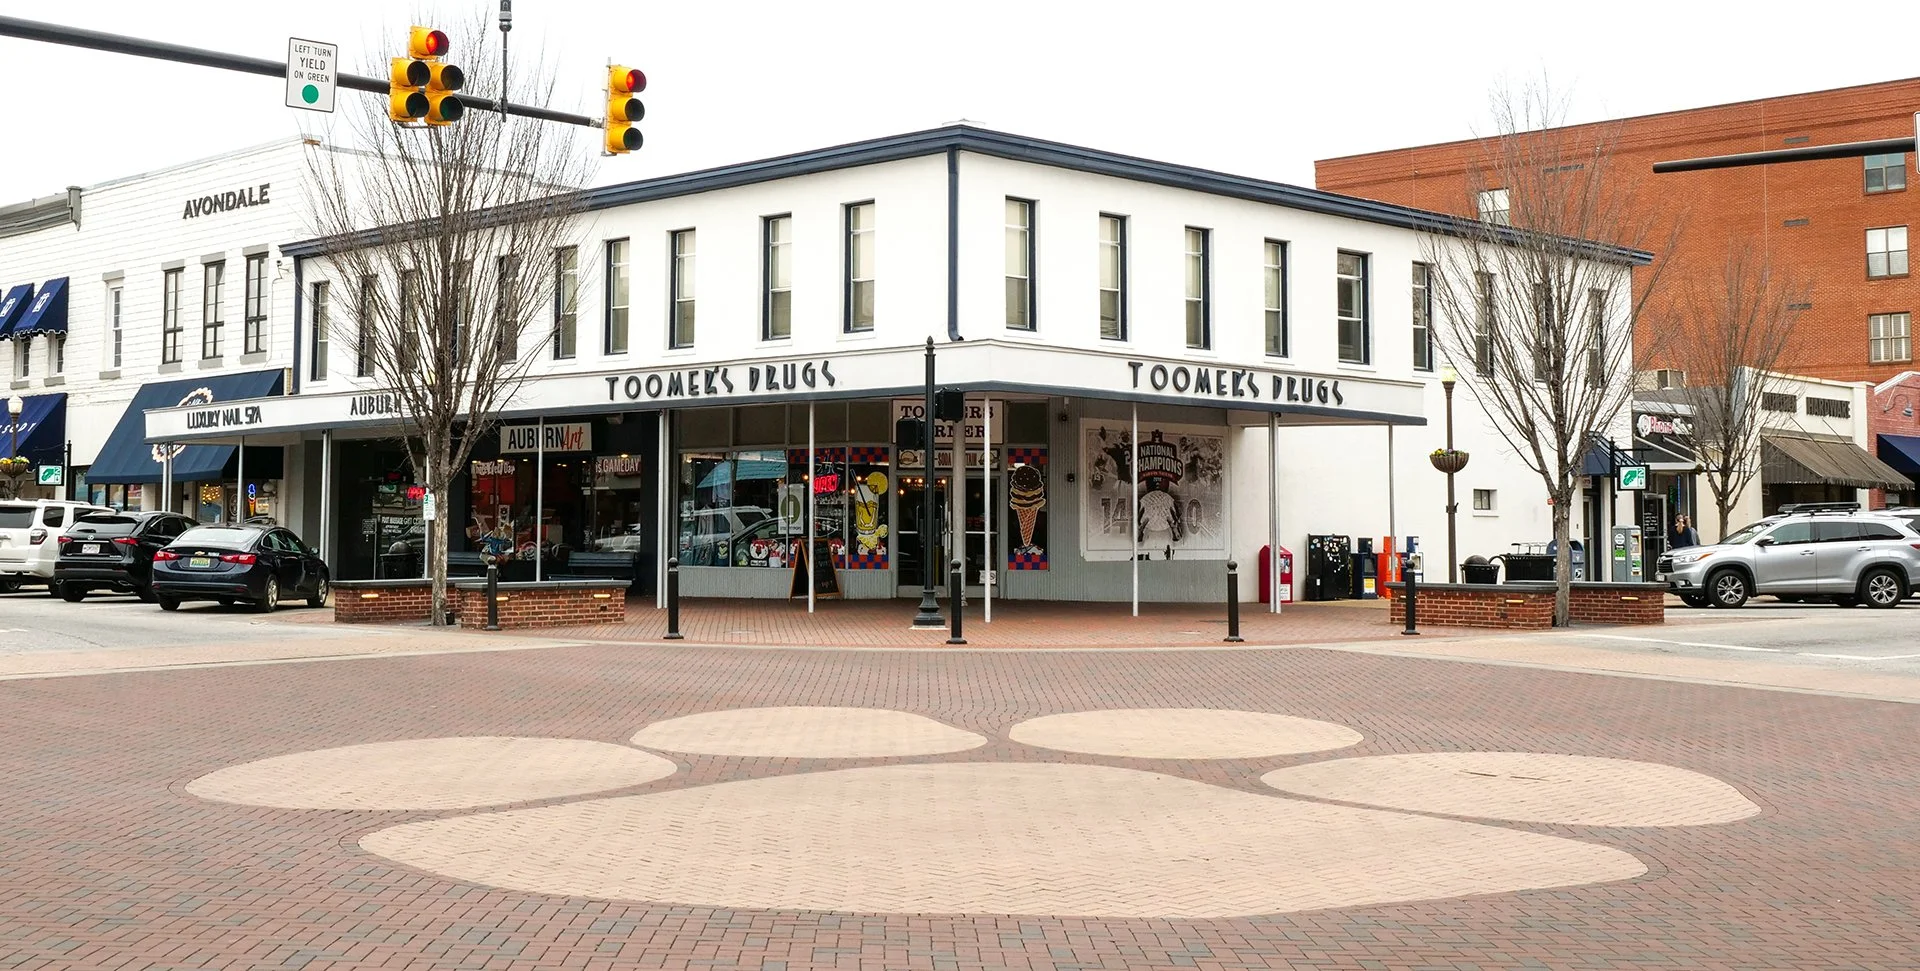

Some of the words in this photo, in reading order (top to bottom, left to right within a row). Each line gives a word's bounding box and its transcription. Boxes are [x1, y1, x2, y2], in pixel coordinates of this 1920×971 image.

[294, 44, 311, 54] LEFT
[312, 46, 332, 57] TURN
[299, 57, 326, 71] YIELD
[294, 70, 304, 79] ON
[307, 72, 330, 83] GREEN
[182, 182, 270, 219] AVONDALE
[605, 365, 734, 400] TOOMER'S
[749, 360, 836, 392] DRUGS
[1128, 361, 1260, 399] TOOMER'S
[1272, 374, 1344, 406] DRUGS
[187, 410, 220, 429] LUXURY
[222, 408, 243, 426] NAIL
[245, 405, 262, 424] SPA
[1806, 396, 1851, 419] HARDWARE
[1140, 445, 1175, 459] NATIONAL
[603, 458, 640, 473] GAMEDAY
[1138, 456, 1182, 476] HAMPIONS
[814, 475, 838, 493] OPEN
